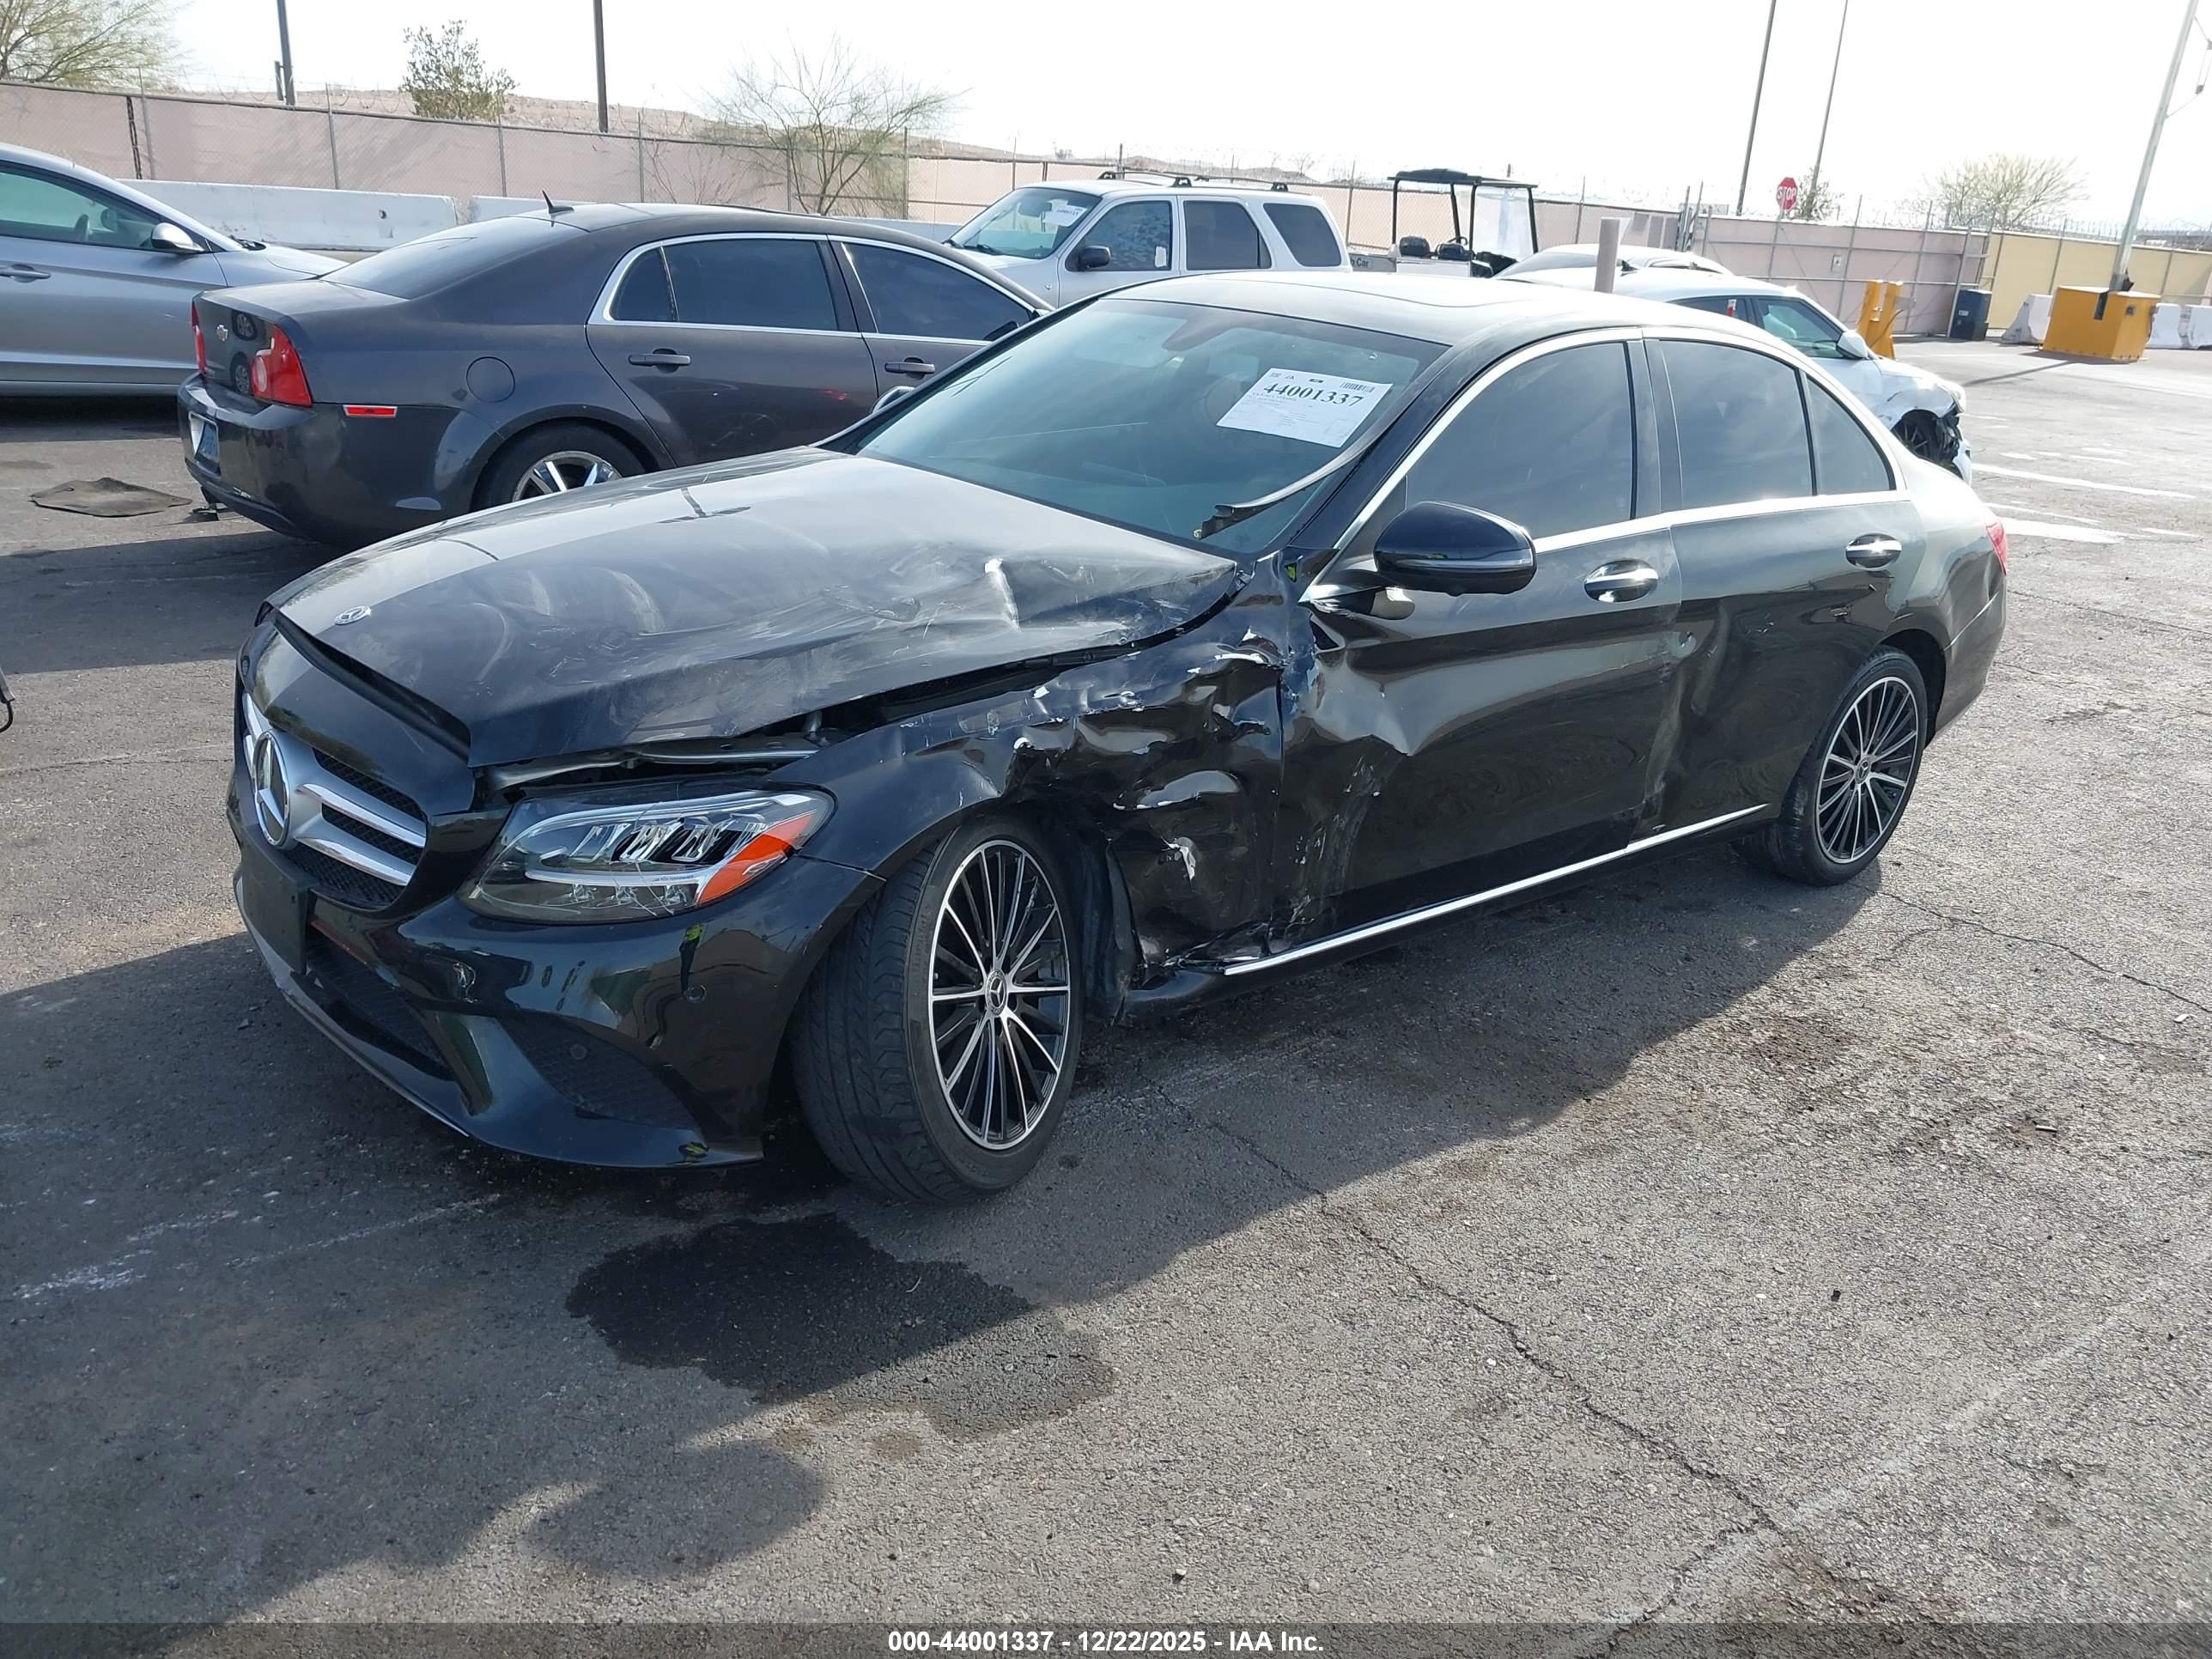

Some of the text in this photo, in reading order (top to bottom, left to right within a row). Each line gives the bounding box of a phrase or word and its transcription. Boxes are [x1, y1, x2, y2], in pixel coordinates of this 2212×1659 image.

[1777, 185, 1797, 200] STOP
[1356, 258, 1369, 268] Car
[1263, 382, 1365, 407] 44001337
